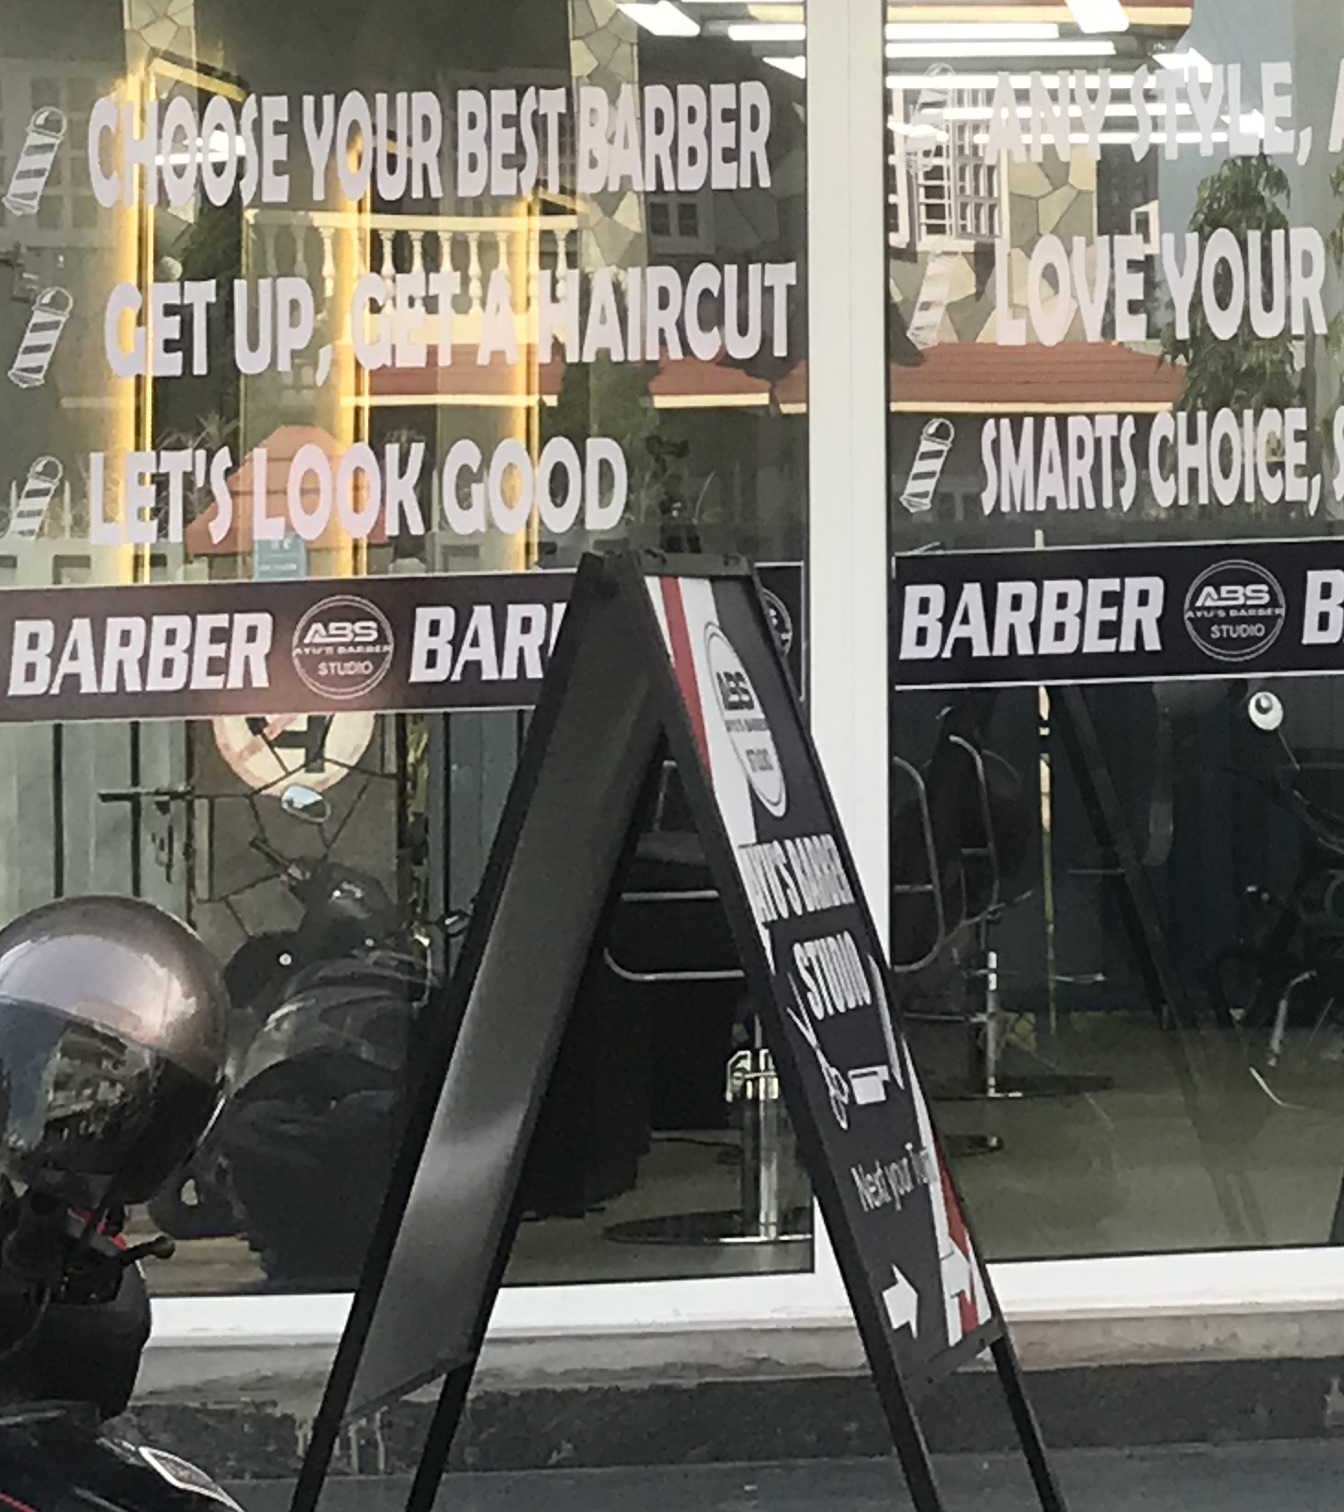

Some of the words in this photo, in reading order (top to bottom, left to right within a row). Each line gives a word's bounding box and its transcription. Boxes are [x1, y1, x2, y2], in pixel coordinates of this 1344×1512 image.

[88, 92, 289, 208] CHOOSE
[302, 90, 443, 202] YOUR
[457, 85, 567, 200] BEST
[576, 80, 772, 194] BARBER
[985, 69, 1111, 165] ANY
[1129, 60, 1312, 166] STYLE,
[104, 278, 217, 378] GET
[232, 276, 333, 387] UP,
[351, 269, 462, 371] GET
[476, 269, 520, 366] A
[538, 261, 797, 363] HAIRCUT
[994, 234, 1148, 347] LOVE
[1161, 226, 1328, 342] YOUR
[89, 444, 235, 546] LET'S
[252, 441, 426, 540] LOOK
[441, 435, 629, 536] GOOD
[980, 410, 1136, 516] SMARTS
[1148, 405, 1322, 517] CHOICE,
[303, 621, 379, 644] ABS
[898, 576, 1165, 660] BARBER
[1194, 583, 1271, 607] ABS
[1210, 622, 1266, 639] STUDIO
[7, 612, 273, 697] BARBER
[317, 660, 375, 676] STUDIO
